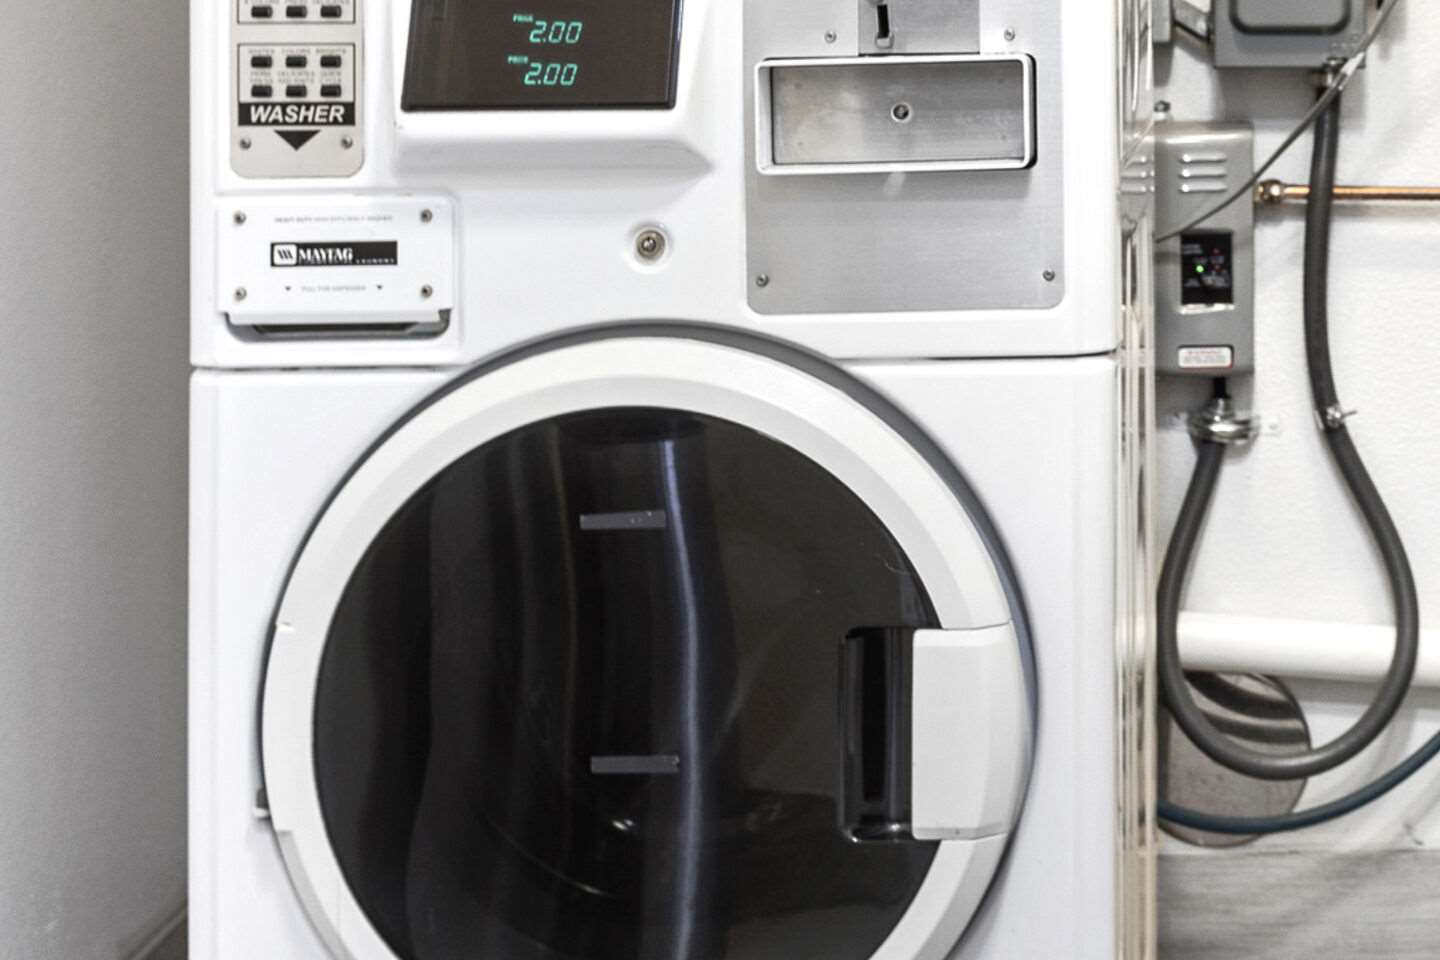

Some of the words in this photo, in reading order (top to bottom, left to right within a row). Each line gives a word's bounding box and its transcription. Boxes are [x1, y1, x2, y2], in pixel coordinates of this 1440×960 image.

[529, 20, 583, 44] 2.00
[523, 62, 578, 86] 2.00
[249, 104, 346, 124] WASHER
[298, 247, 353, 262] MAYTAG
